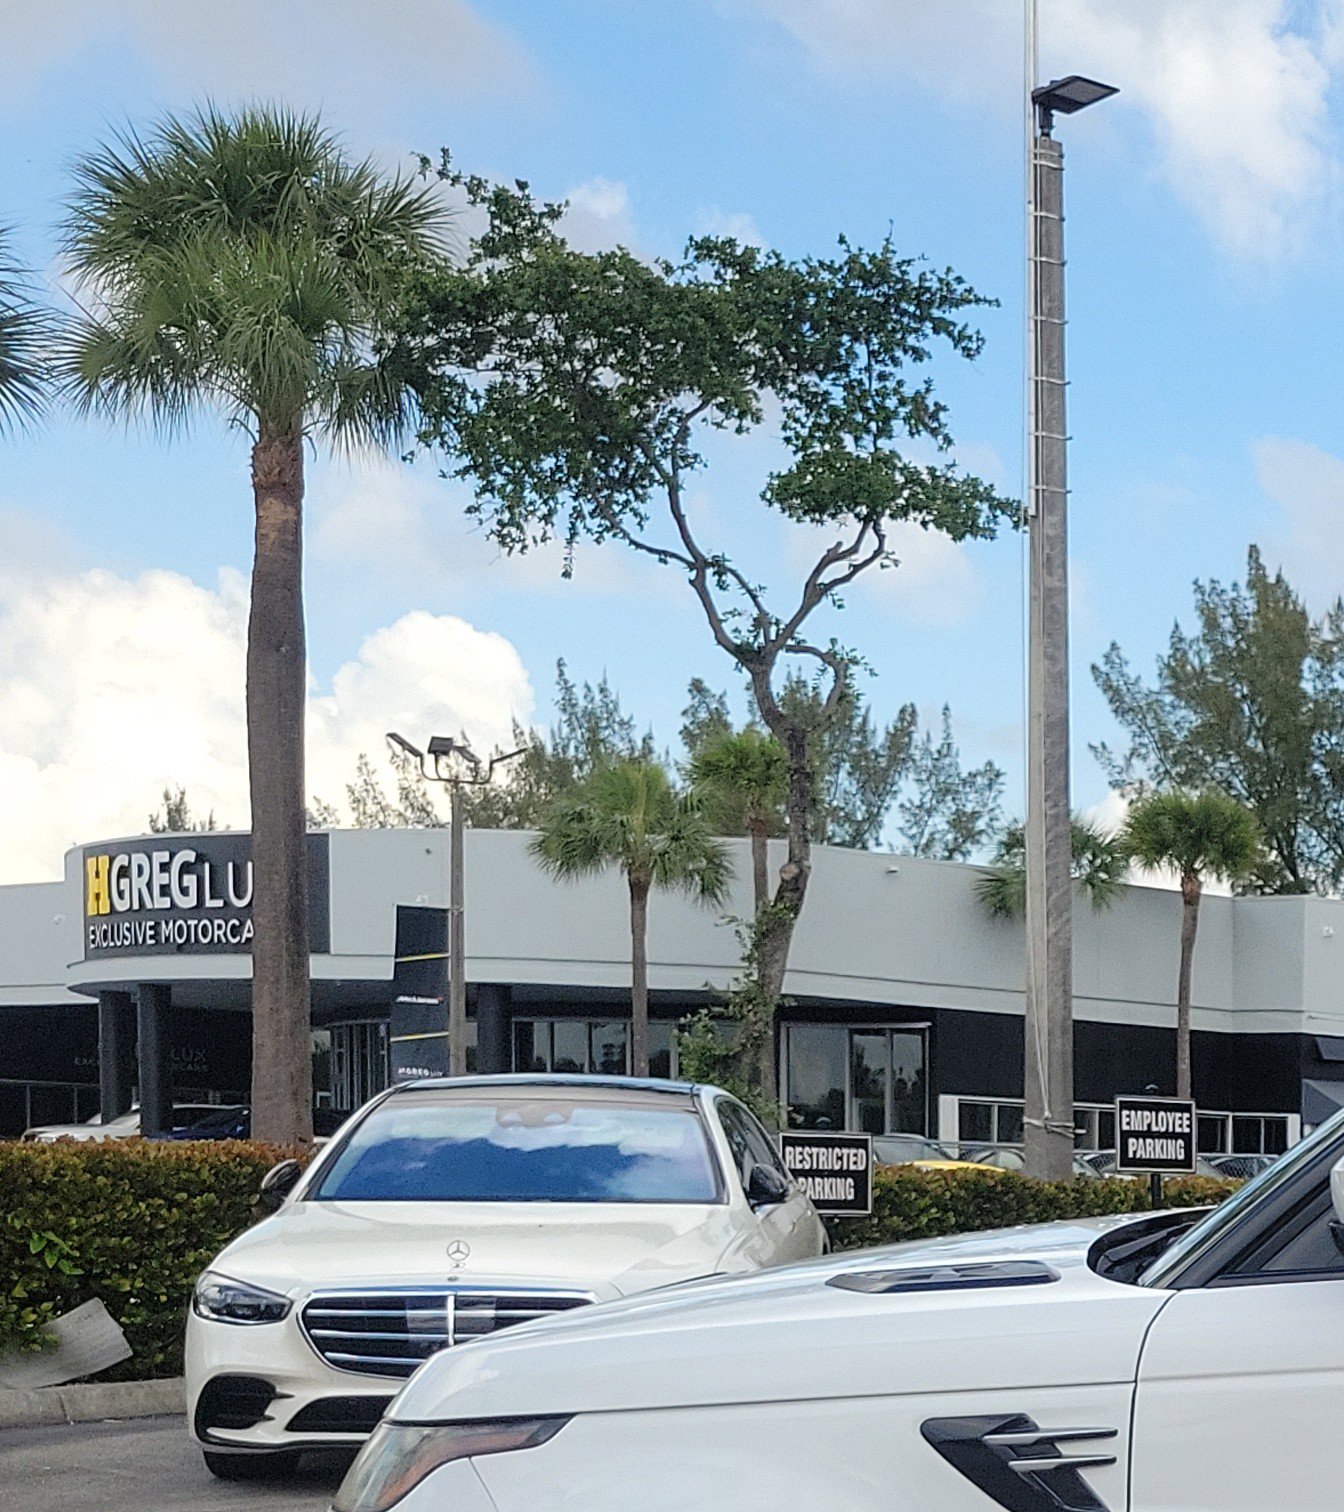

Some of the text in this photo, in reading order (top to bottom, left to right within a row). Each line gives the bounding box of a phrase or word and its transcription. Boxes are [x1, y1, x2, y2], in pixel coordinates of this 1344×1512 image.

[204, 861, 254, 908] LU
[89, 918, 255, 949] EXCLUSIVE MOTORCA
[1121, 1109, 1191, 1133] EMPLOYEE
[784, 1145, 867, 1171] RESTRICTED
[1127, 1137, 1185, 1160] PARKING
[797, 1176, 855, 1201] PARKING
